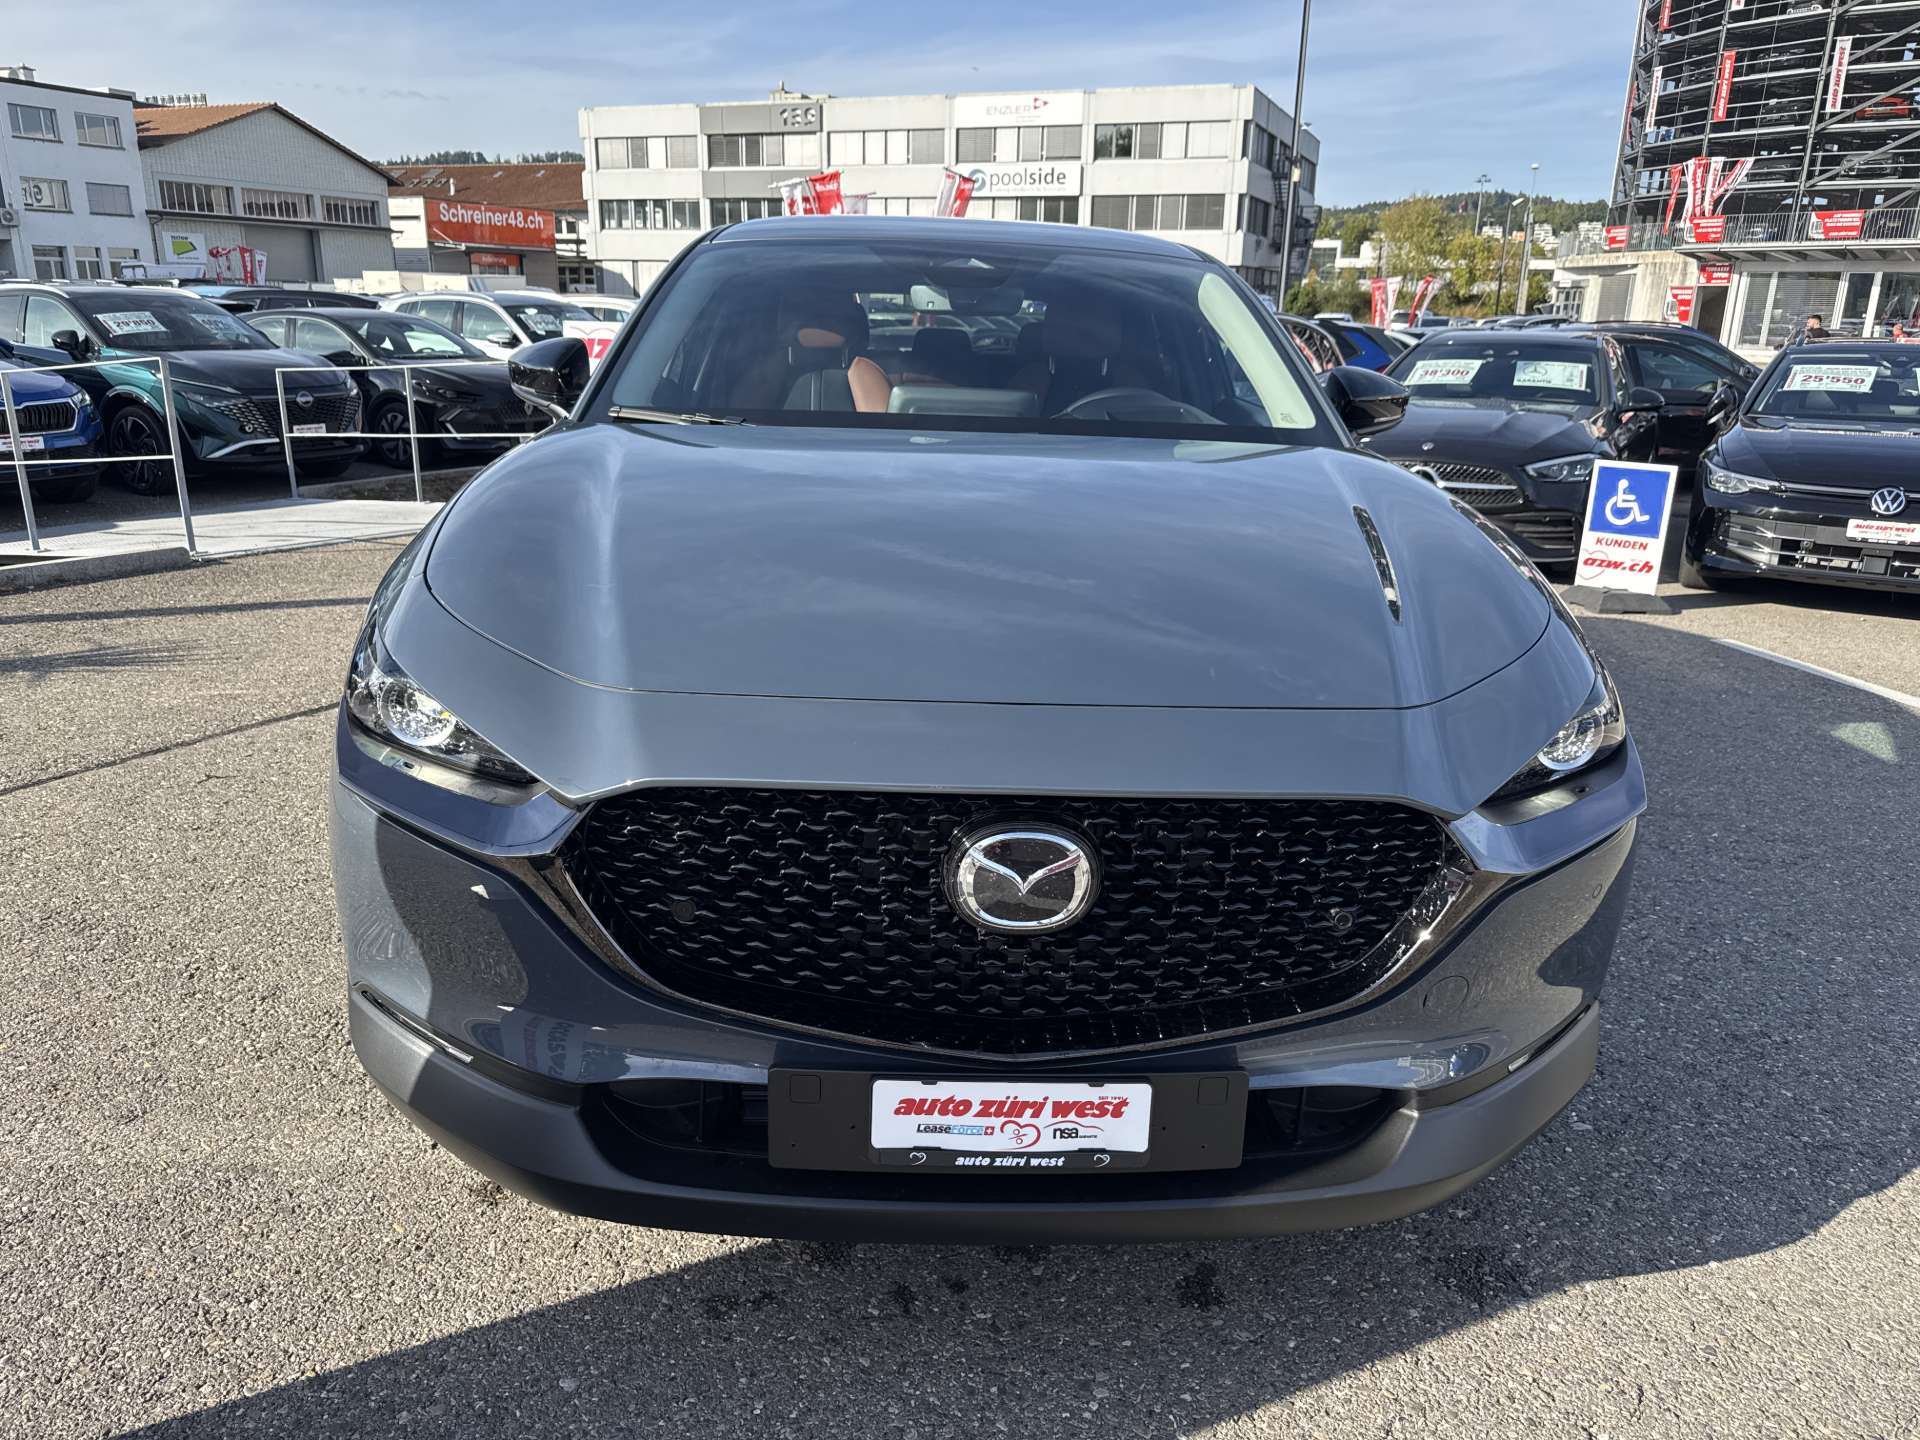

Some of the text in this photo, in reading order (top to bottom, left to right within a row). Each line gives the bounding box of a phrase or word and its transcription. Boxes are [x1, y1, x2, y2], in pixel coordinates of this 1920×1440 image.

[986, 105, 1031, 116] ENZLER
[990, 167, 1066, 192] poolside
[439, 202, 544, 229] Schreiner48.ch
[1801, 374, 1866, 385] 25'550
[1595, 536, 1649, 551] KUNDEN
[1583, 557, 1654, 574] azw.ch
[894, 1094, 1129, 1119] auto züri west
[1053, 1127, 1079, 1139] nsa
[954, 1155, 1065, 1167] auto züri west
